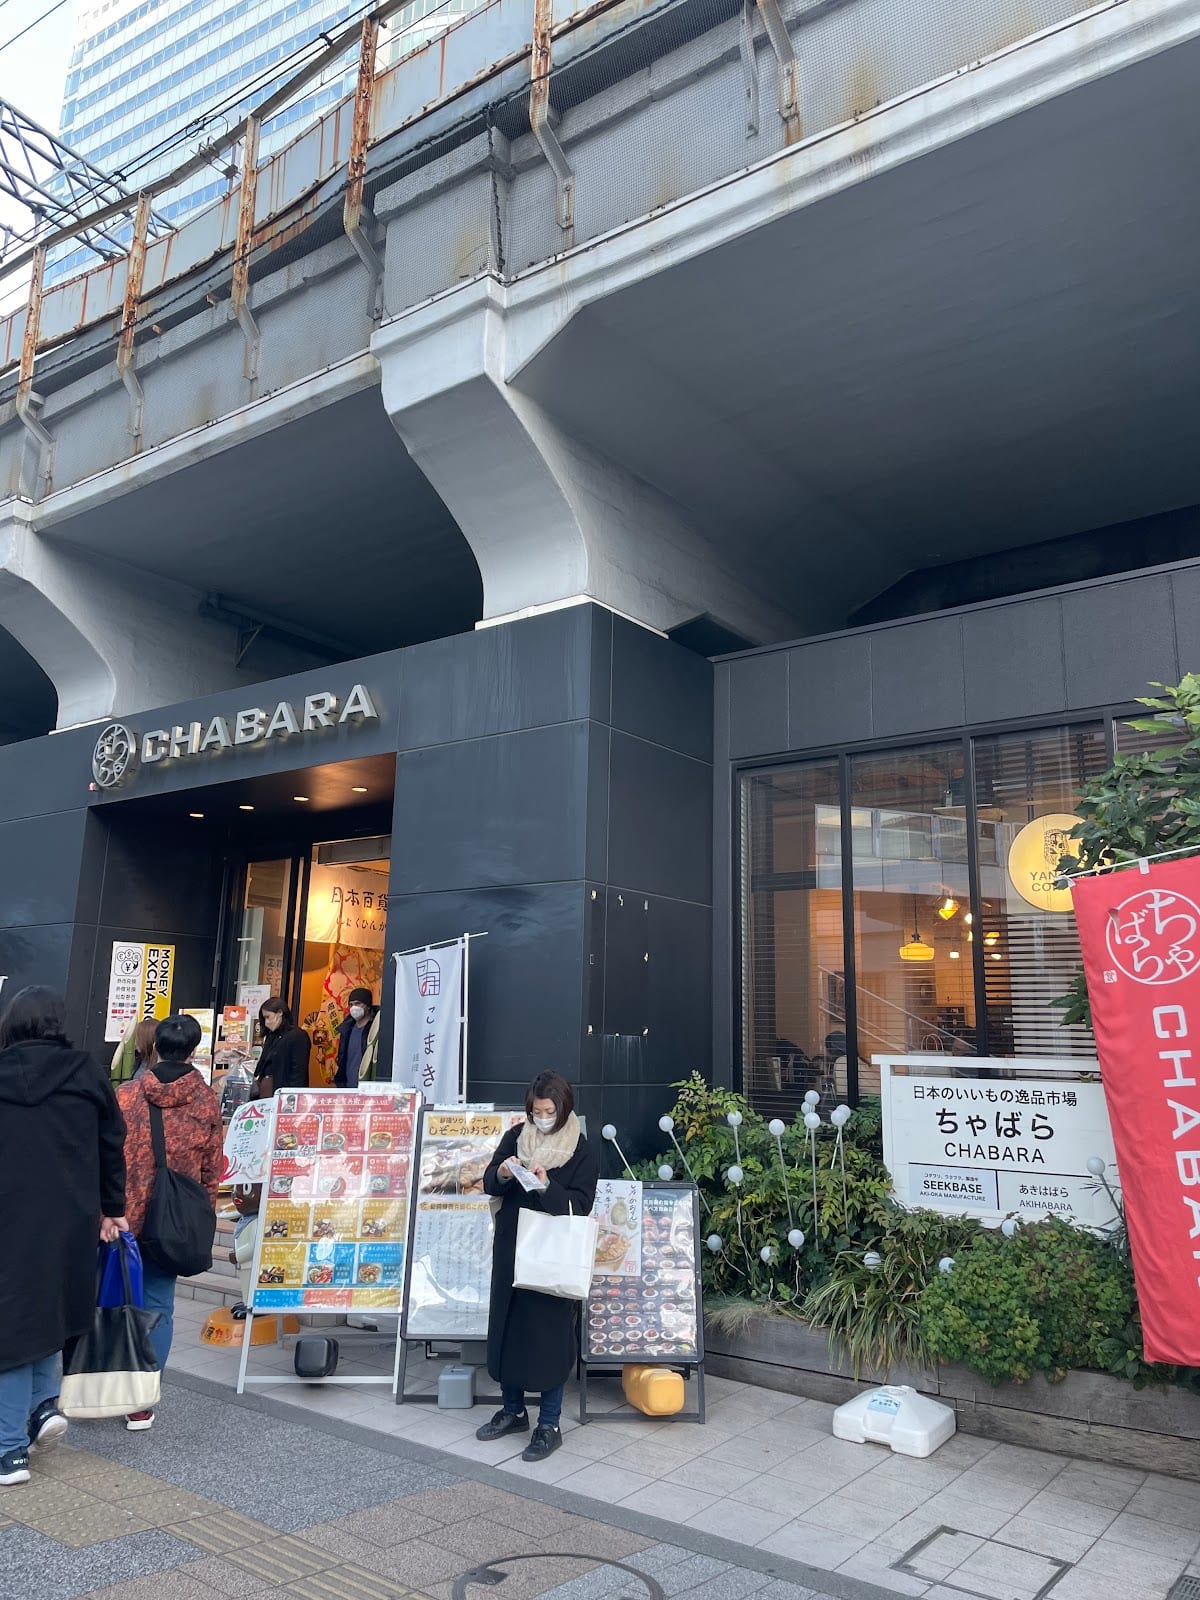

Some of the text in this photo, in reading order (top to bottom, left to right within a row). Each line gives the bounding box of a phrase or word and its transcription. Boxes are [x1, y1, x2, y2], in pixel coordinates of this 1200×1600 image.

[141, 684, 378, 764] CHABARA
[1030, 871, 1057, 880] YAN
[159, 949, 171, 997] MONEY
[421, 1005, 437, 1090] こまき
[913, 1085, 1078, 1107] 日本のいいもの逸品市場
[935, 1107, 1055, 1140] ちゃばら
[944, 1142, 1046, 1164] CHABARA
[923, 1180, 983, 1194] SEEKBASE
[1018, 1183, 1070, 1198] あきはばら
[1019, 1200, 1073, 1212] AKIHABARA
